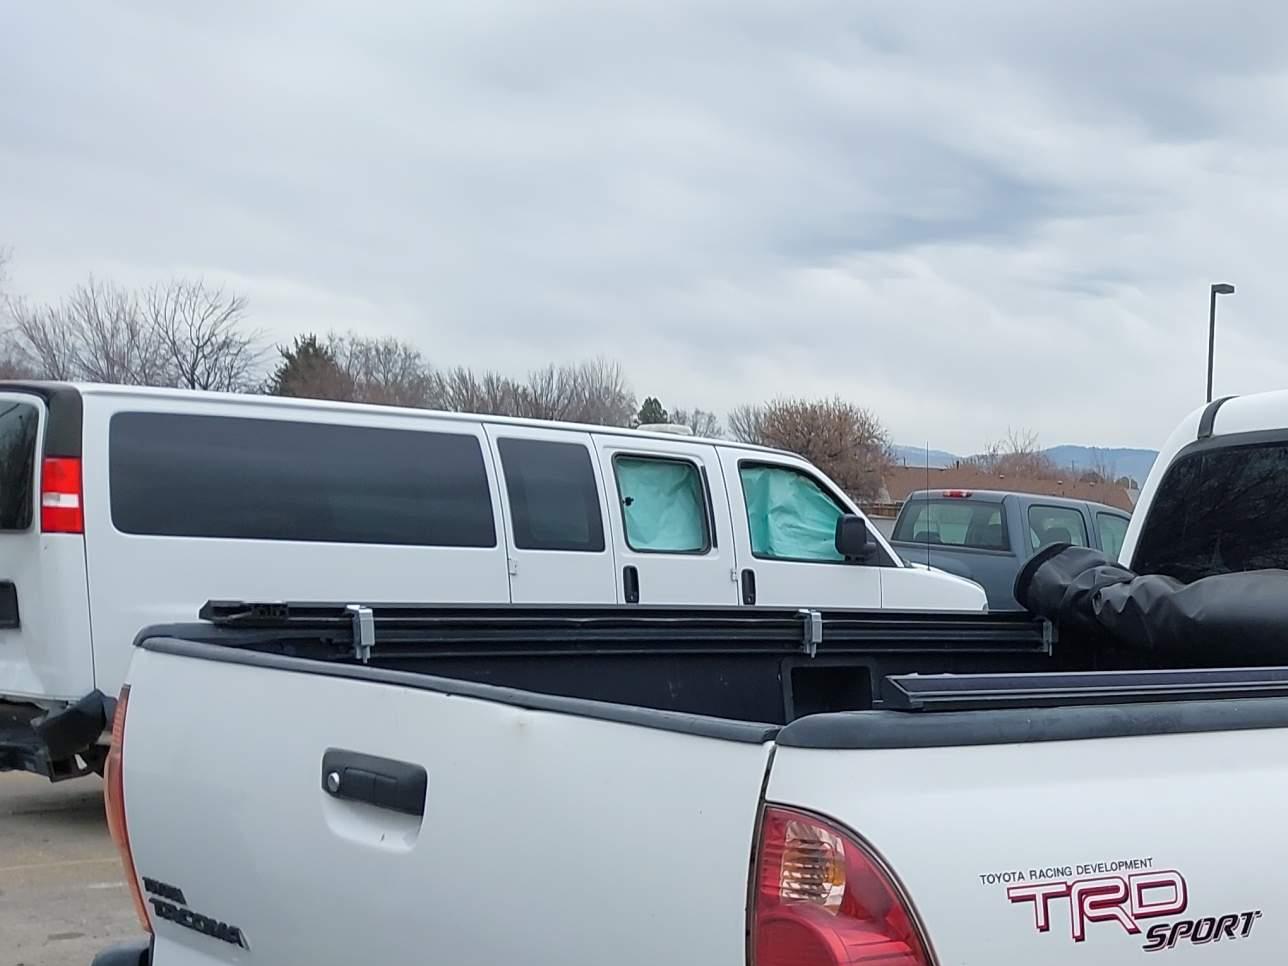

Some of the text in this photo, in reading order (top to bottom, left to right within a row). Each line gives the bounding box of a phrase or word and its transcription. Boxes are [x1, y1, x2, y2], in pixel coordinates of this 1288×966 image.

[979, 858, 1153, 885] TOYOTA RACING DEVELOPMENT
[1007, 870, 1188, 942] TRD
[1142, 911, 1262, 951] SPORT
